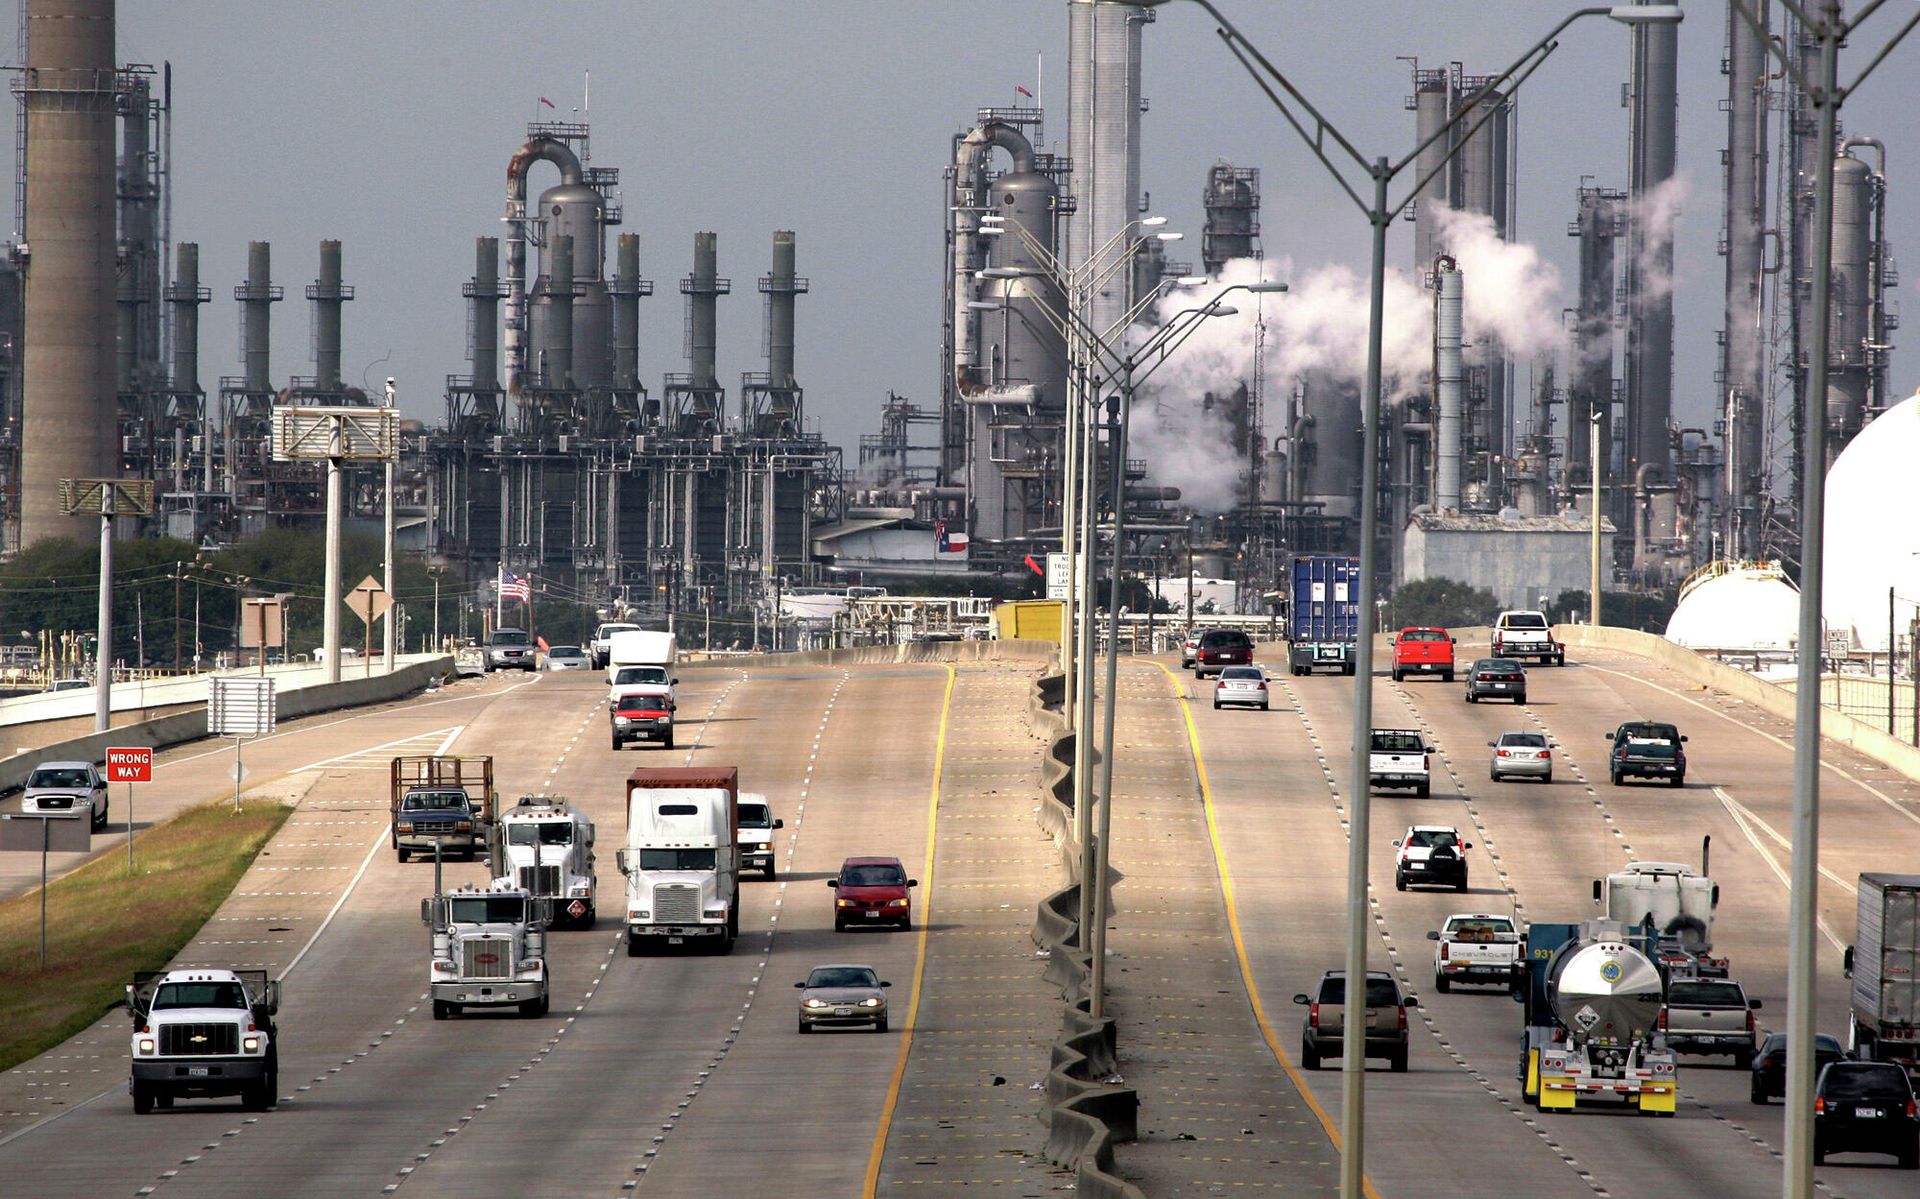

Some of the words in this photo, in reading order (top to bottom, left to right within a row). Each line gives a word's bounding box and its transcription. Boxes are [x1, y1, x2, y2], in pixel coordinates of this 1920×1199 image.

[1831, 643, 1846, 651] 225
[109, 753, 149, 764] WRONG
[117, 767, 141, 777] WAY
